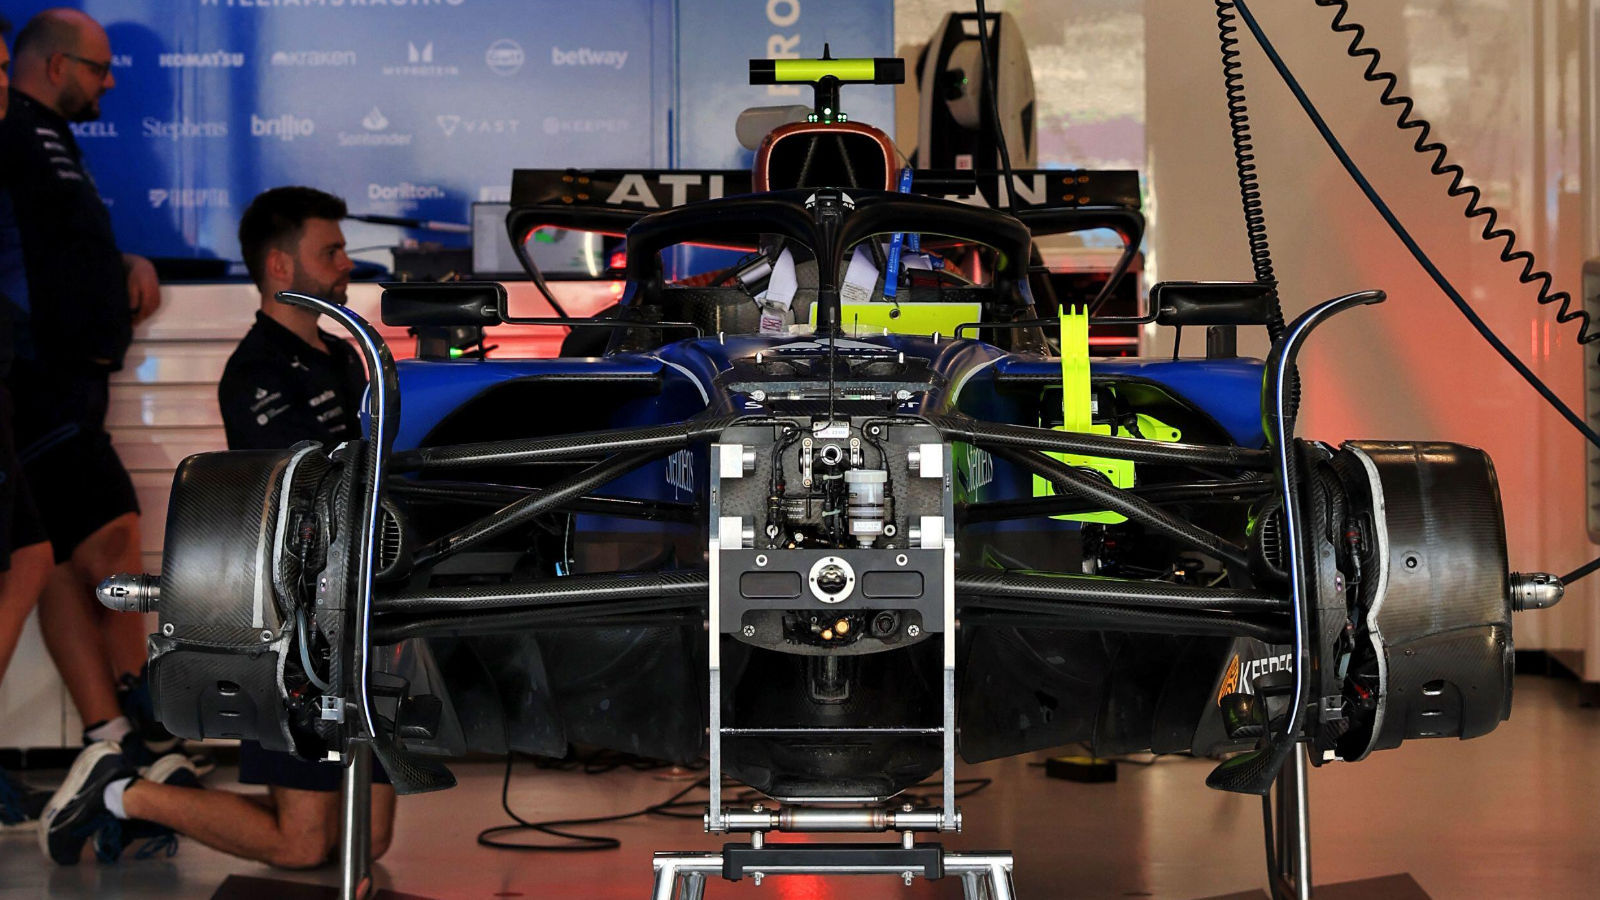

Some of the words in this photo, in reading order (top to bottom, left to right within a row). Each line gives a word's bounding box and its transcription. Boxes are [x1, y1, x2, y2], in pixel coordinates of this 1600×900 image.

[159, 50, 244, 68] KOMATSU
[552, 47, 628, 69] betway
[142, 117, 228, 141] Stephens
